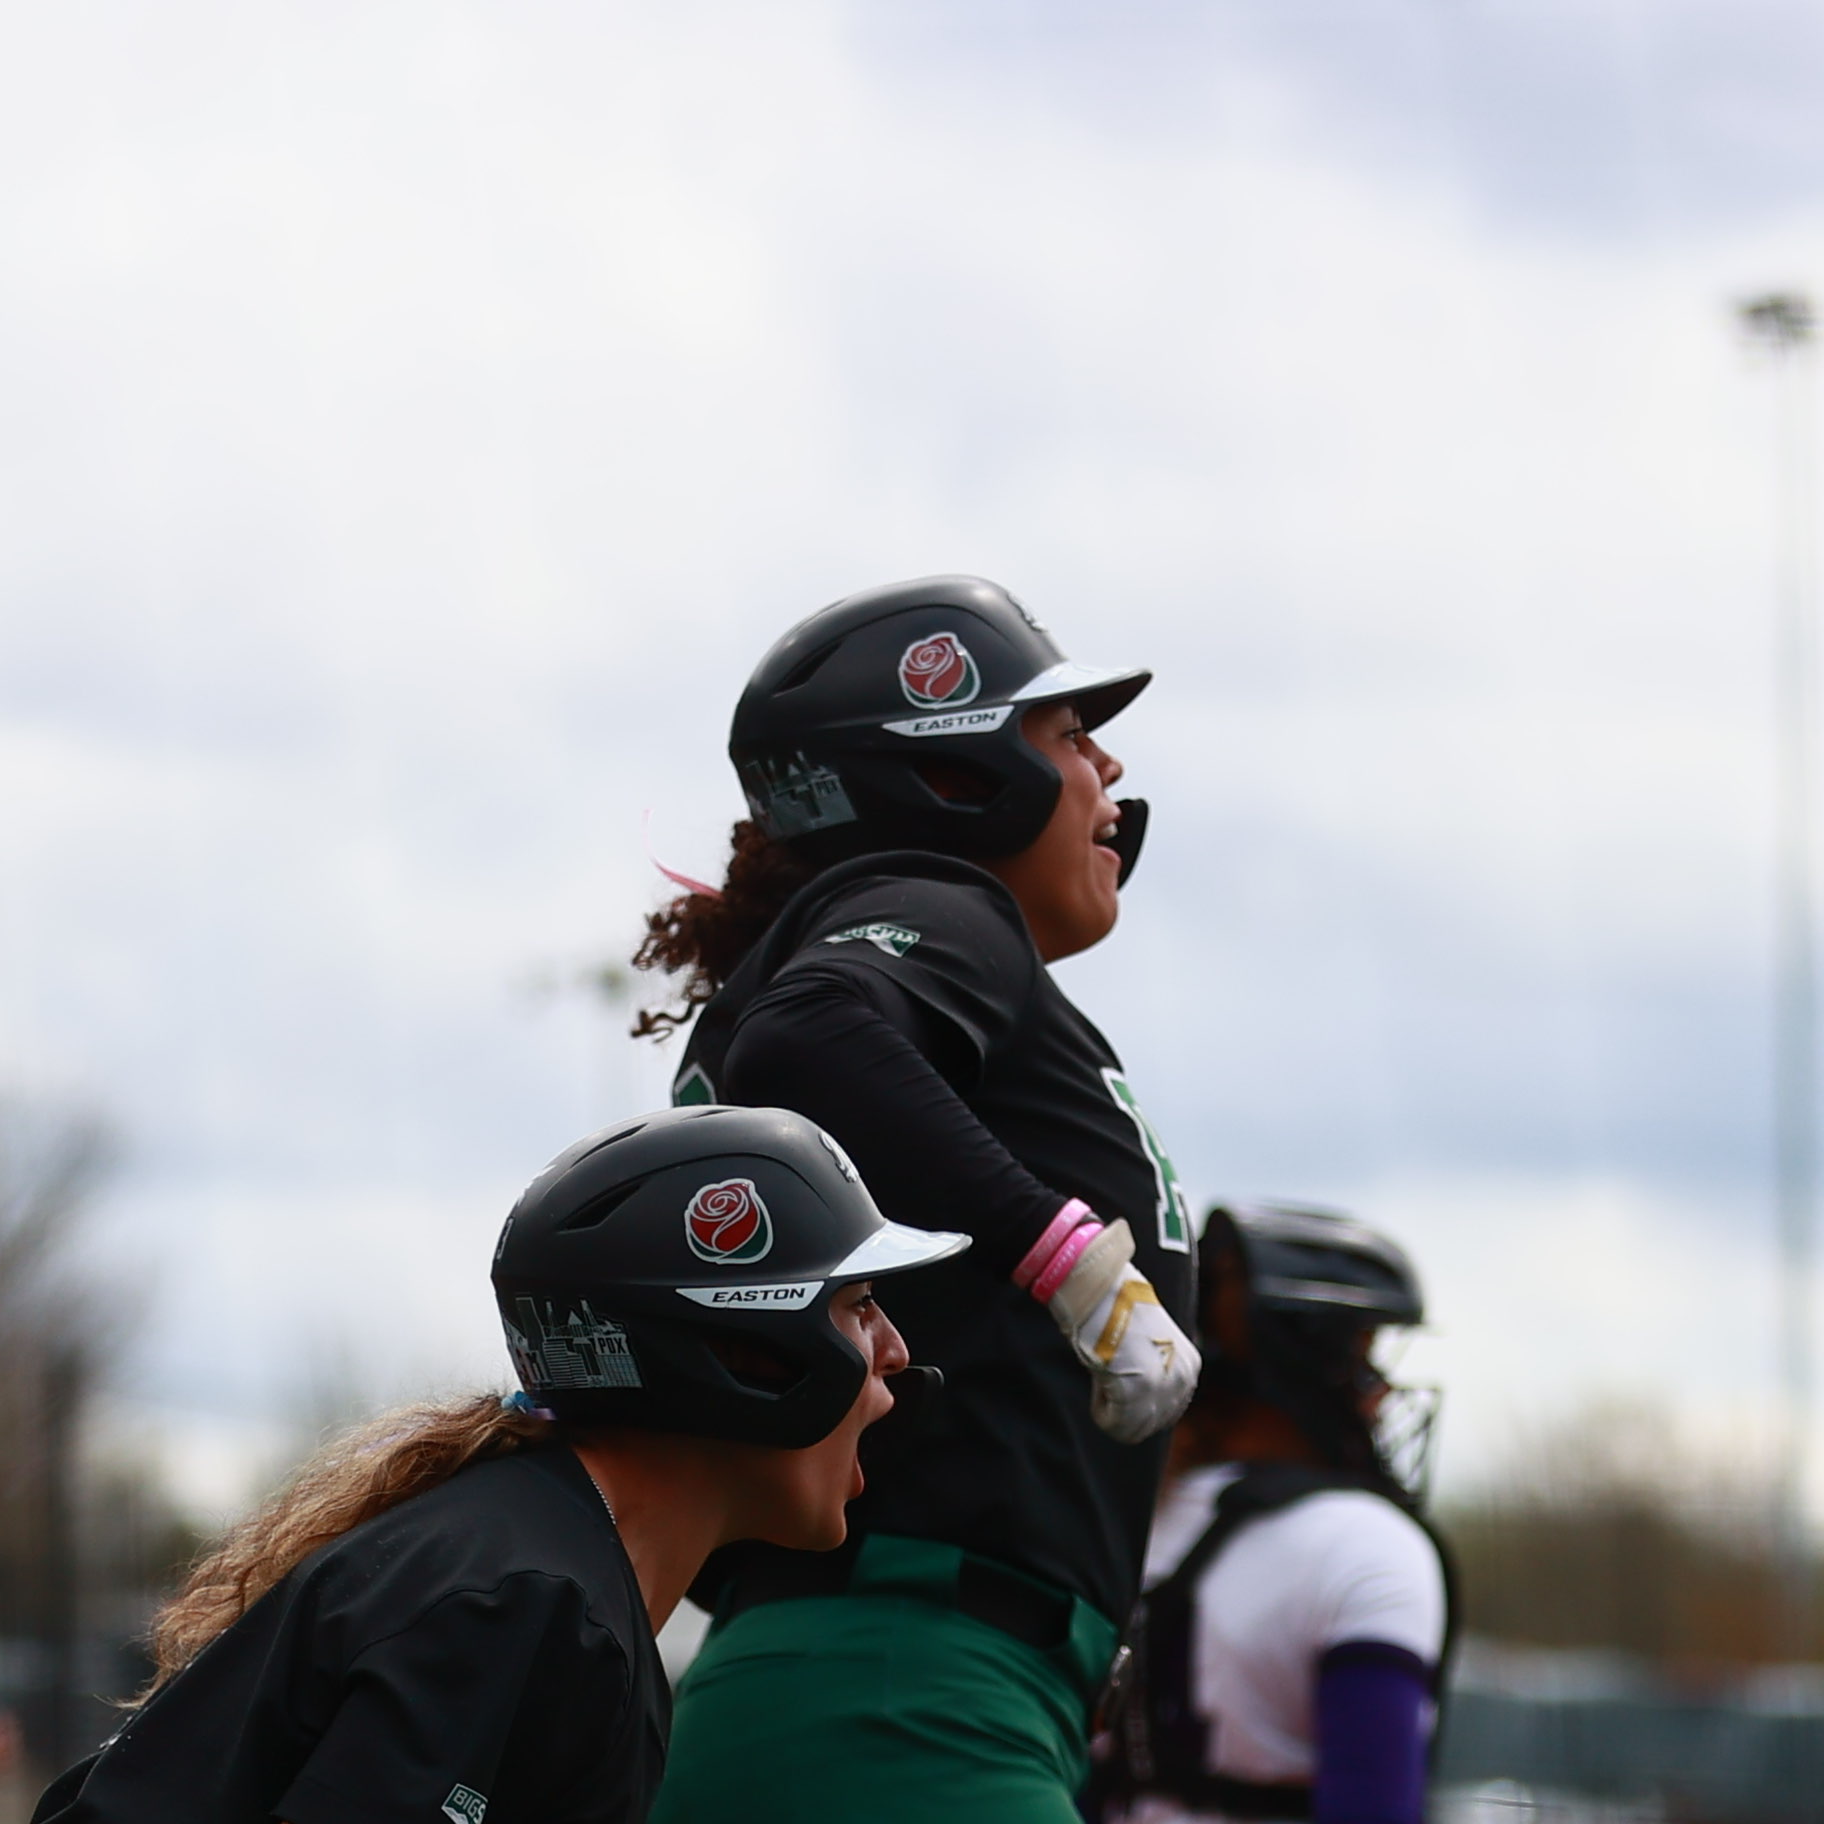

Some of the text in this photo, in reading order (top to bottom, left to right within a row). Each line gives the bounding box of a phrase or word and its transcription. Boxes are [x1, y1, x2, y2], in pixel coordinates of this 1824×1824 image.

[912, 711, 997, 733] EASTON
[711, 1287, 806, 1303] EASTON
[598, 1337, 627, 1355] PDX
